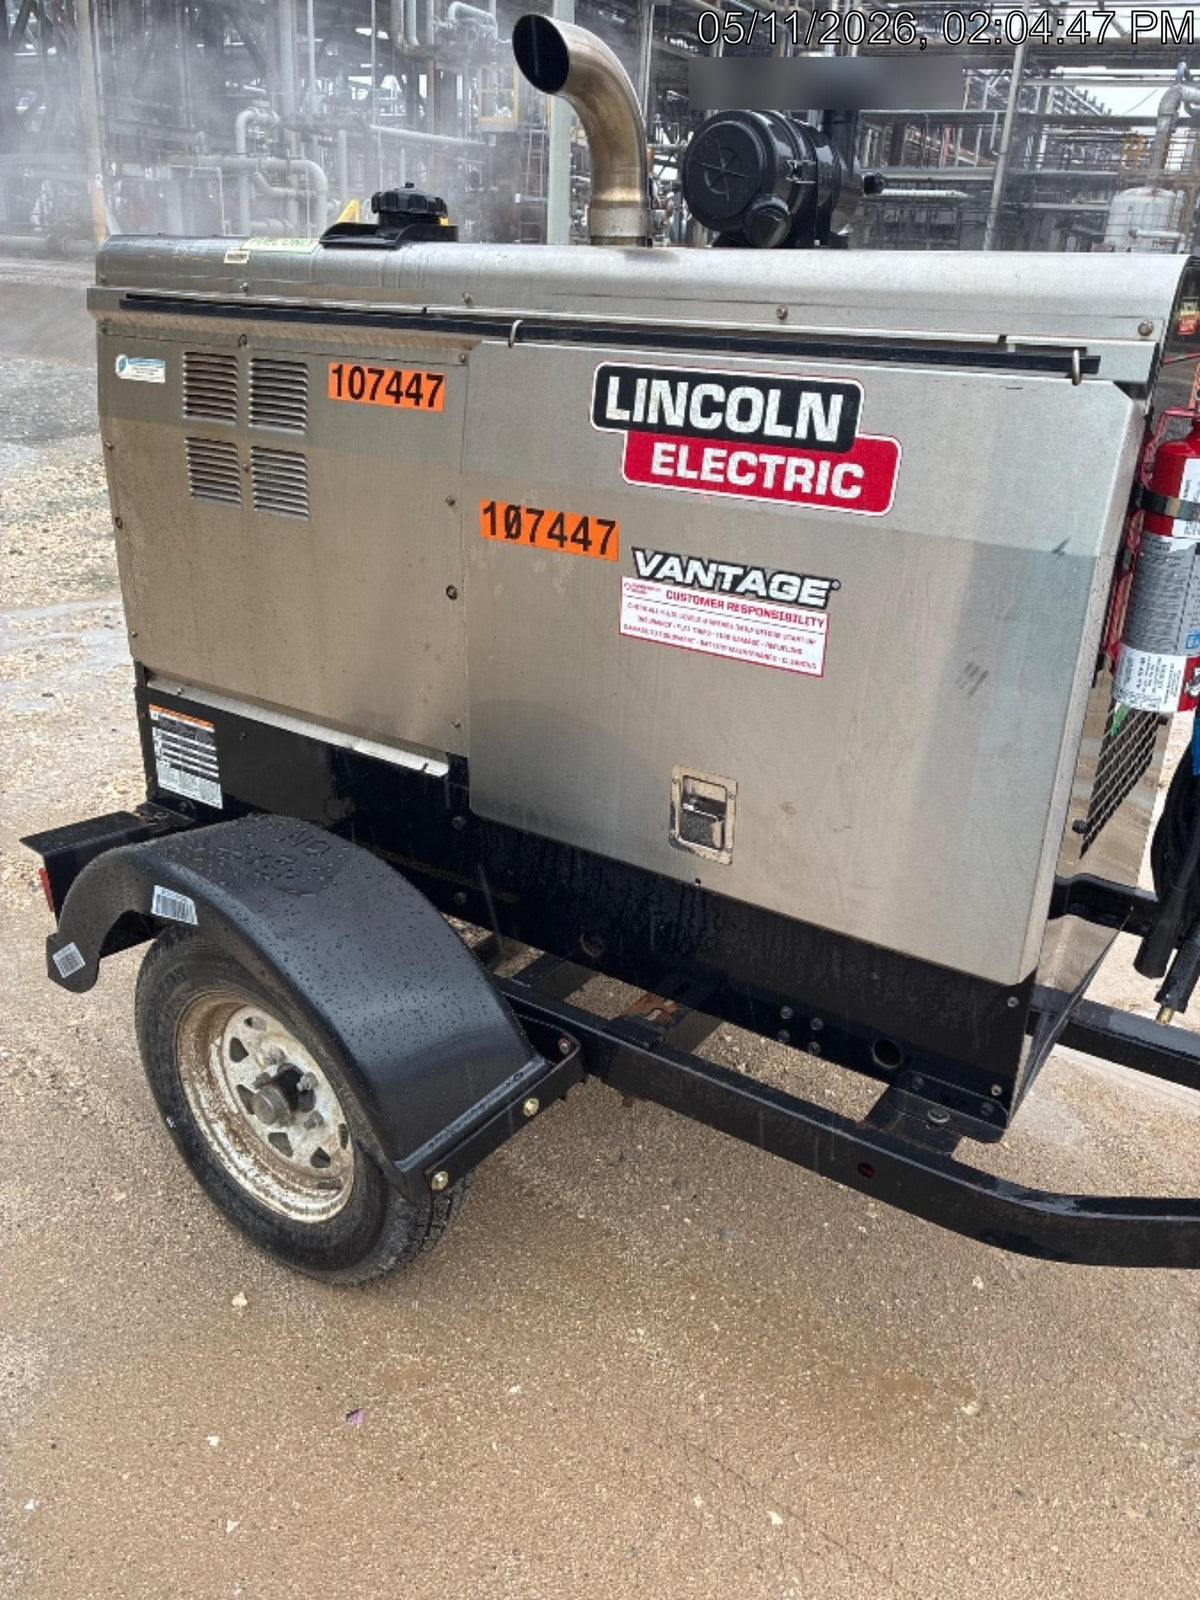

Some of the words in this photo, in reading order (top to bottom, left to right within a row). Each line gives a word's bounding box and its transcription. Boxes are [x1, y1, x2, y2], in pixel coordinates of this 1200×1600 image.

[331, 363, 444, 408] 107447
[605, 375, 844, 443] LINCOLN
[651, 441, 865, 500] ELECTRIC
[482, 500, 617, 555] 107447
[633, 549, 831, 608] VANTAGE
[665, 590, 725, 610] CUSTOMER
[726, 601, 825, 629] RESPONSIBILITY
